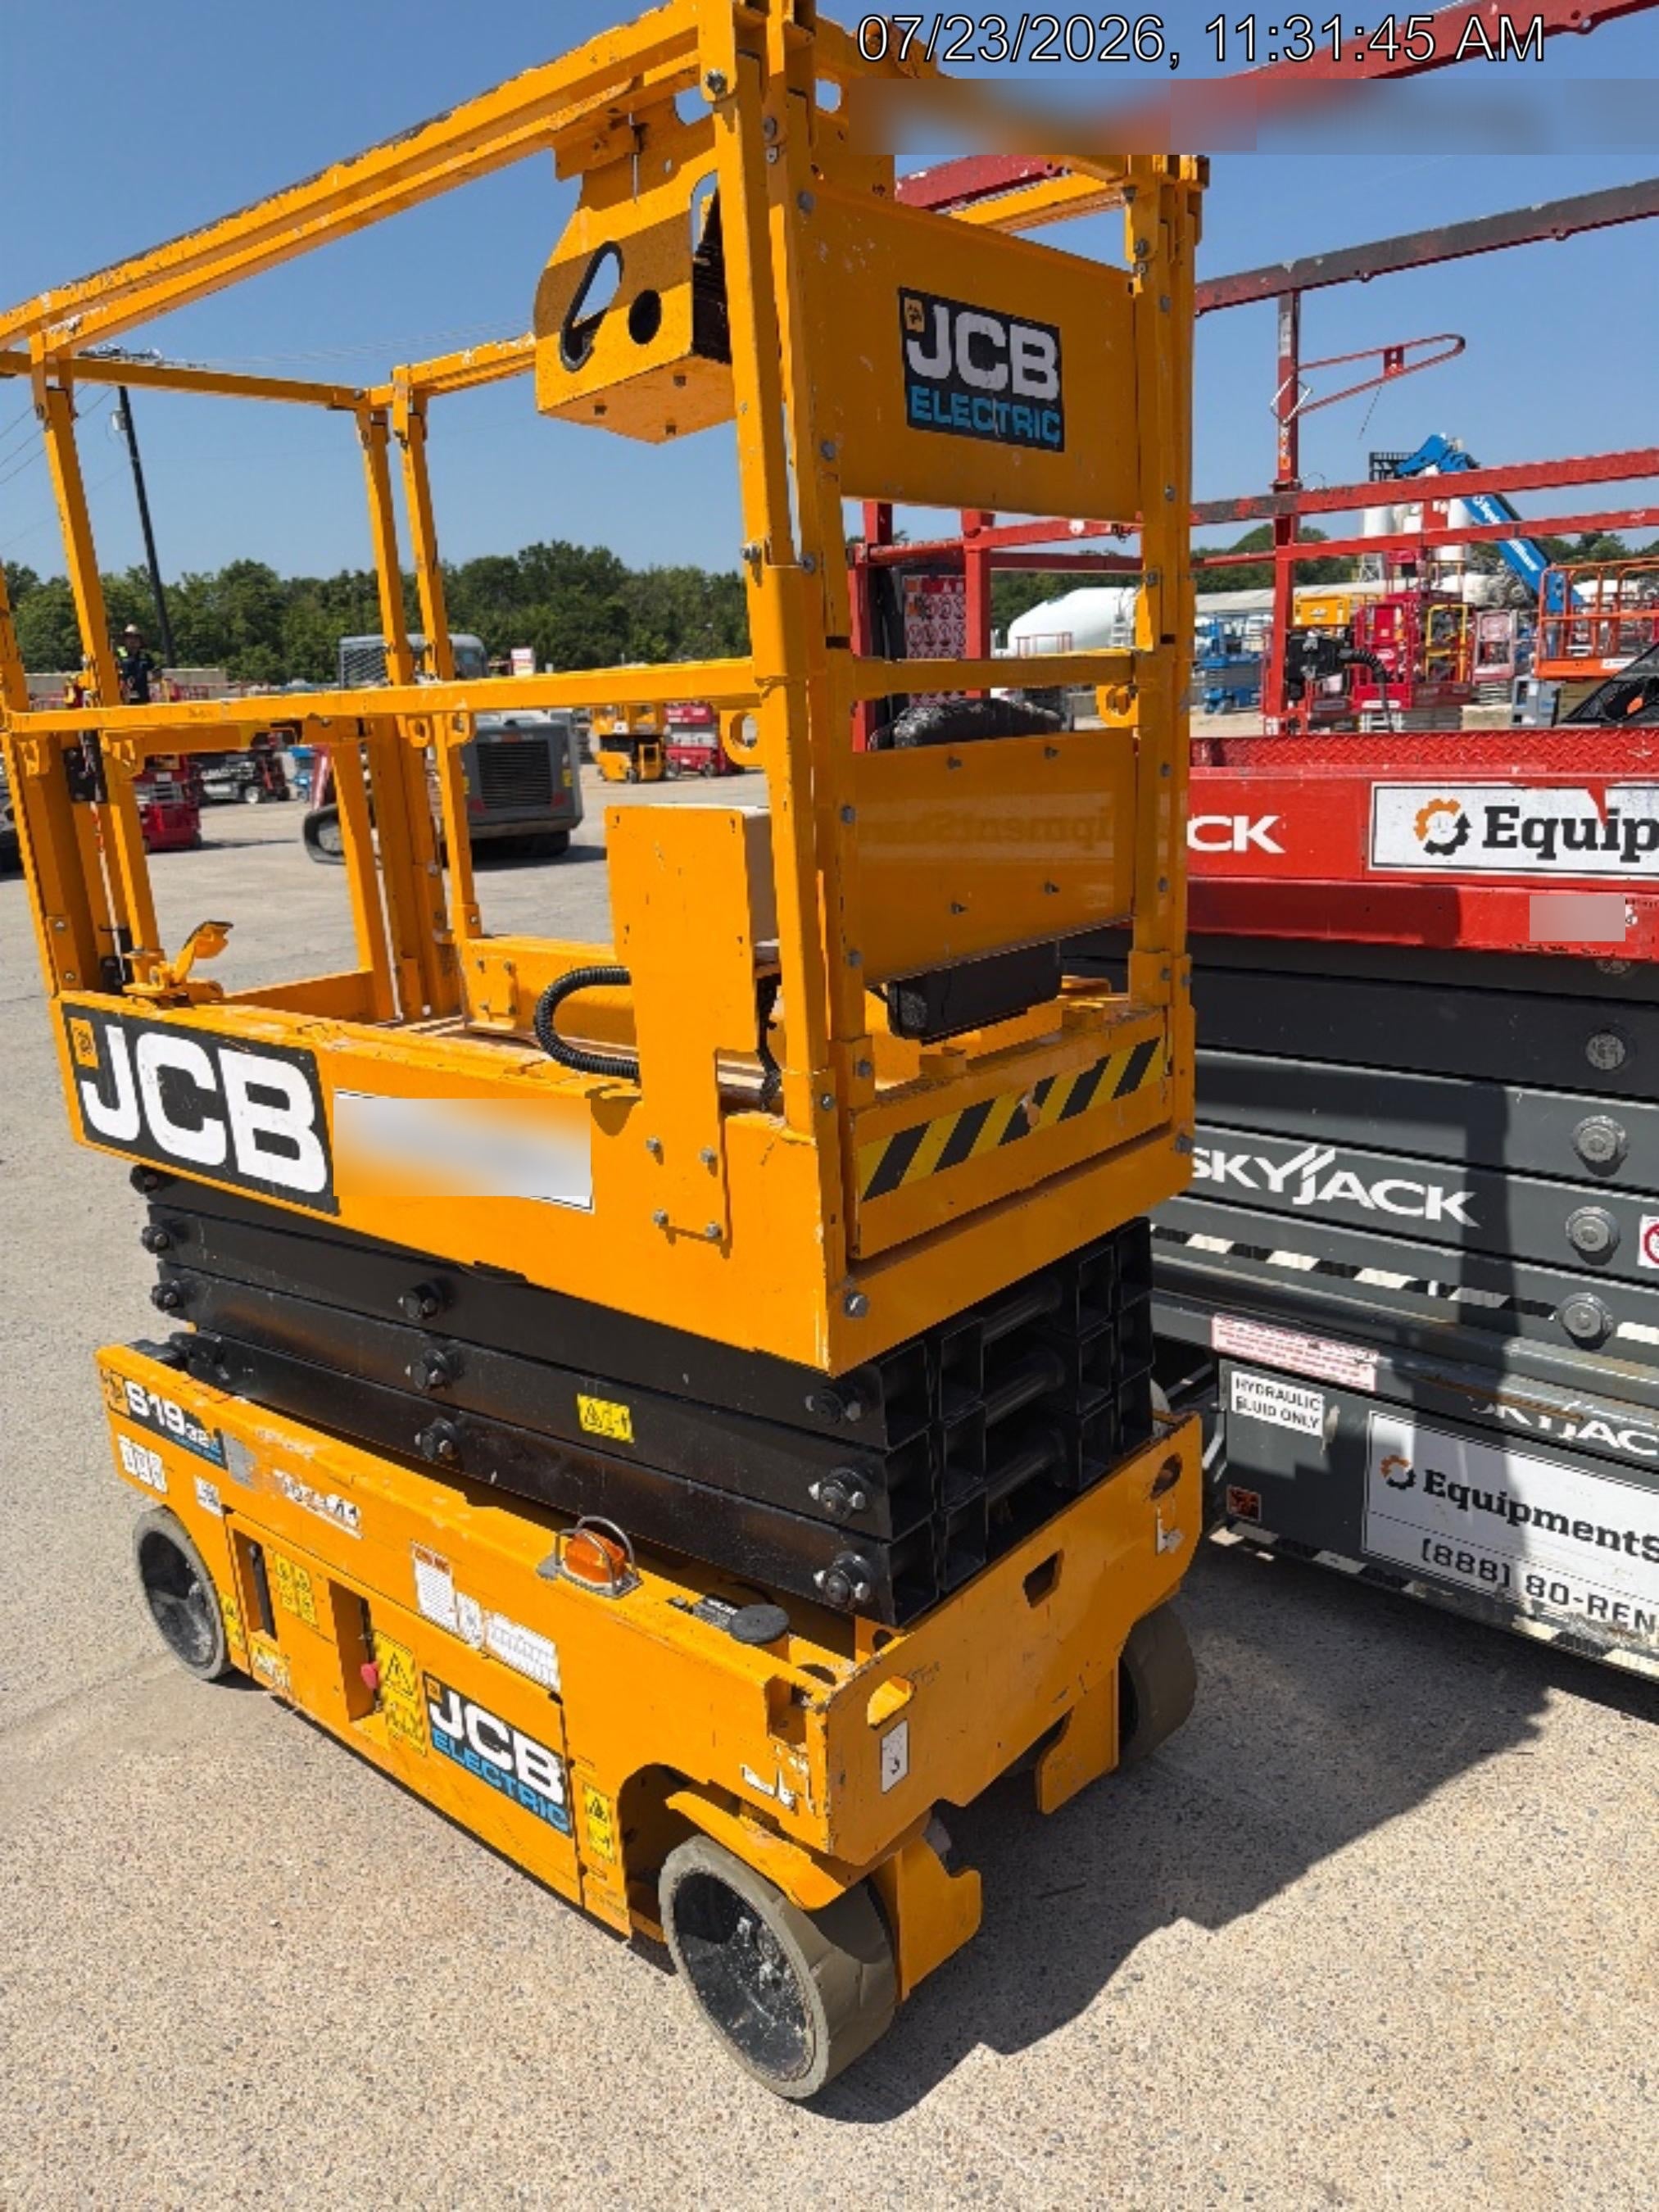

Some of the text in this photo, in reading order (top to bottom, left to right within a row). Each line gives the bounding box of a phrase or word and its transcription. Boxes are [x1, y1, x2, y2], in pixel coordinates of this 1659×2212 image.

[906, 304, 1060, 401] JCB
[911, 385, 1061, 443] ELECTRIC
[79, 1024, 328, 1194] JCB
[1192, 1144, 1480, 1228] SKYJACK
[1235, 1378, 1321, 1411] HYDRAULIC
[1280, 1407, 1321, 1429] ONLY
[1424, 1469, 1659, 1564] EquipmentS
[429, 1690, 564, 1805] JCB
[432, 1729, 569, 1831] ELECTRIC
